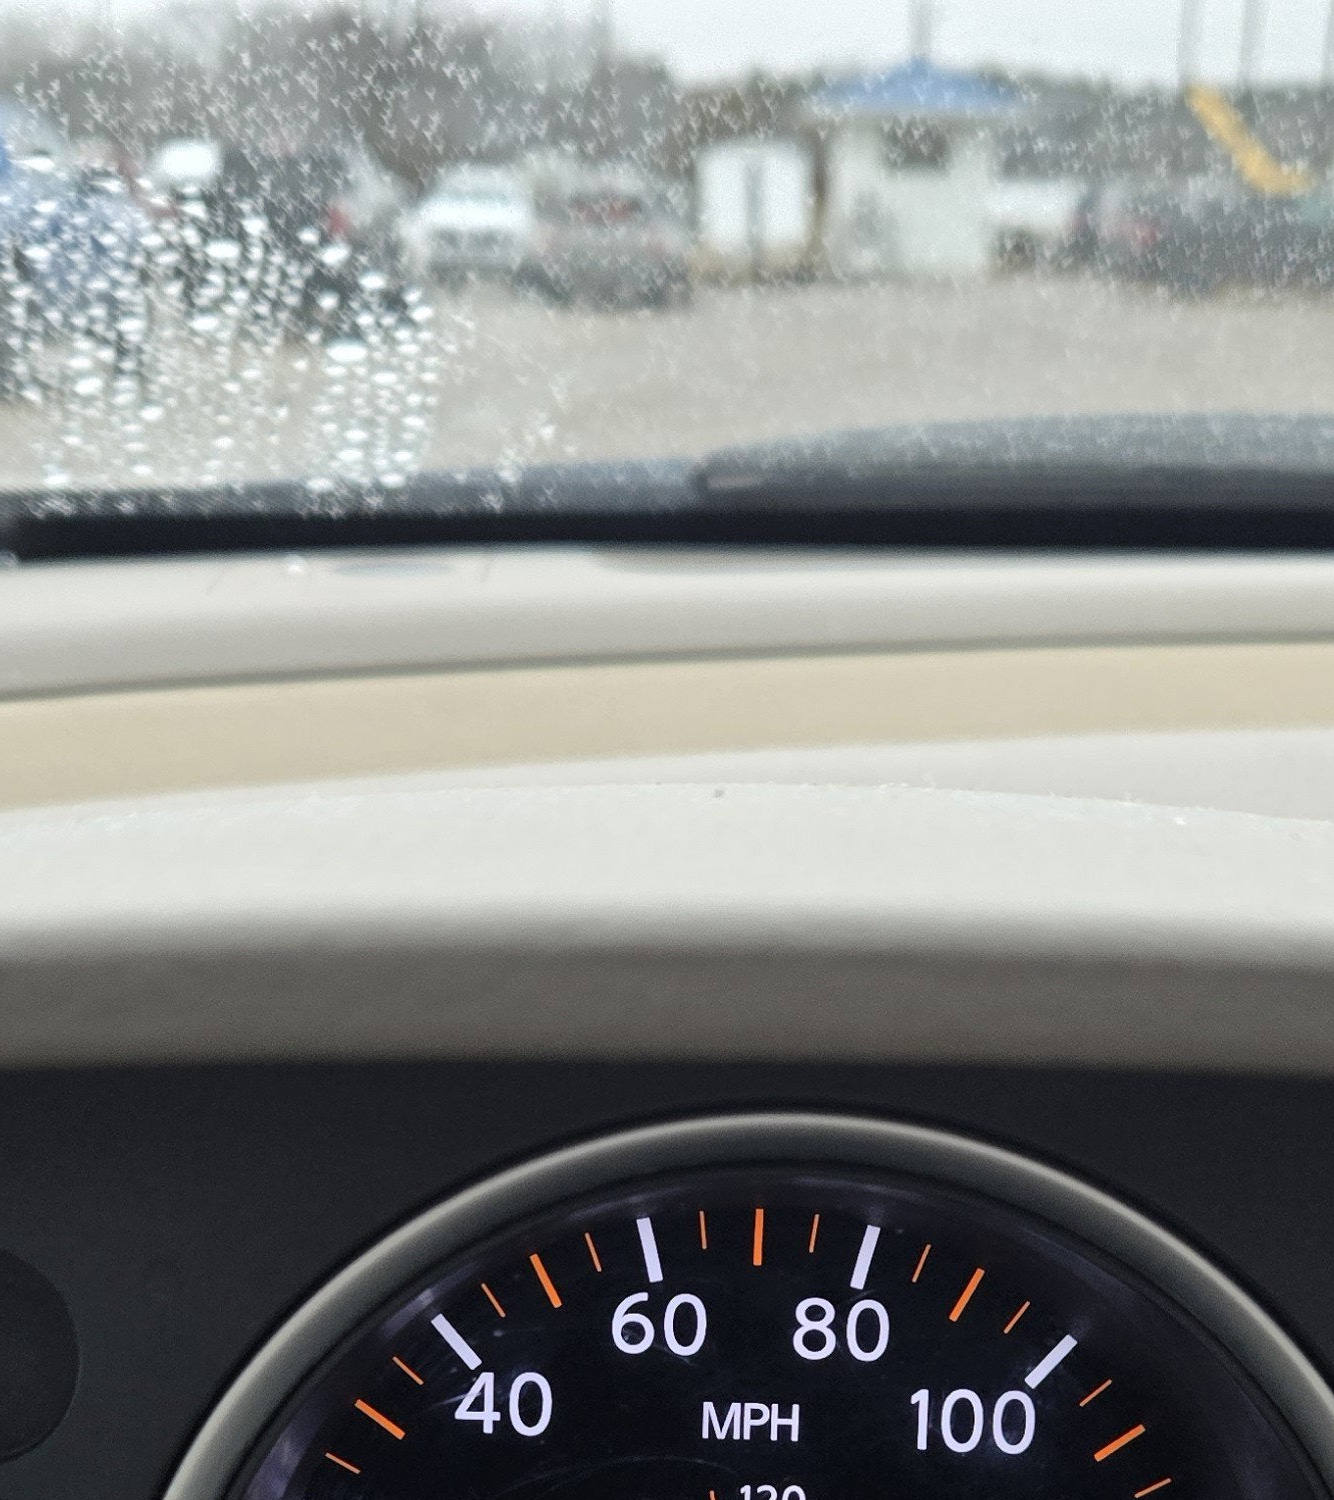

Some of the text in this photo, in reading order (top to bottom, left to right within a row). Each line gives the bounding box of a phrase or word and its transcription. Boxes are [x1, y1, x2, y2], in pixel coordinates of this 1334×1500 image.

[612, 1292, 706, 1356] 60
[793, 1298, 889, 1361] 80
[454, 1371, 553, 1437] 40
[702, 1402, 799, 1441] MPH
[910, 1389, 1037, 1456] 100
